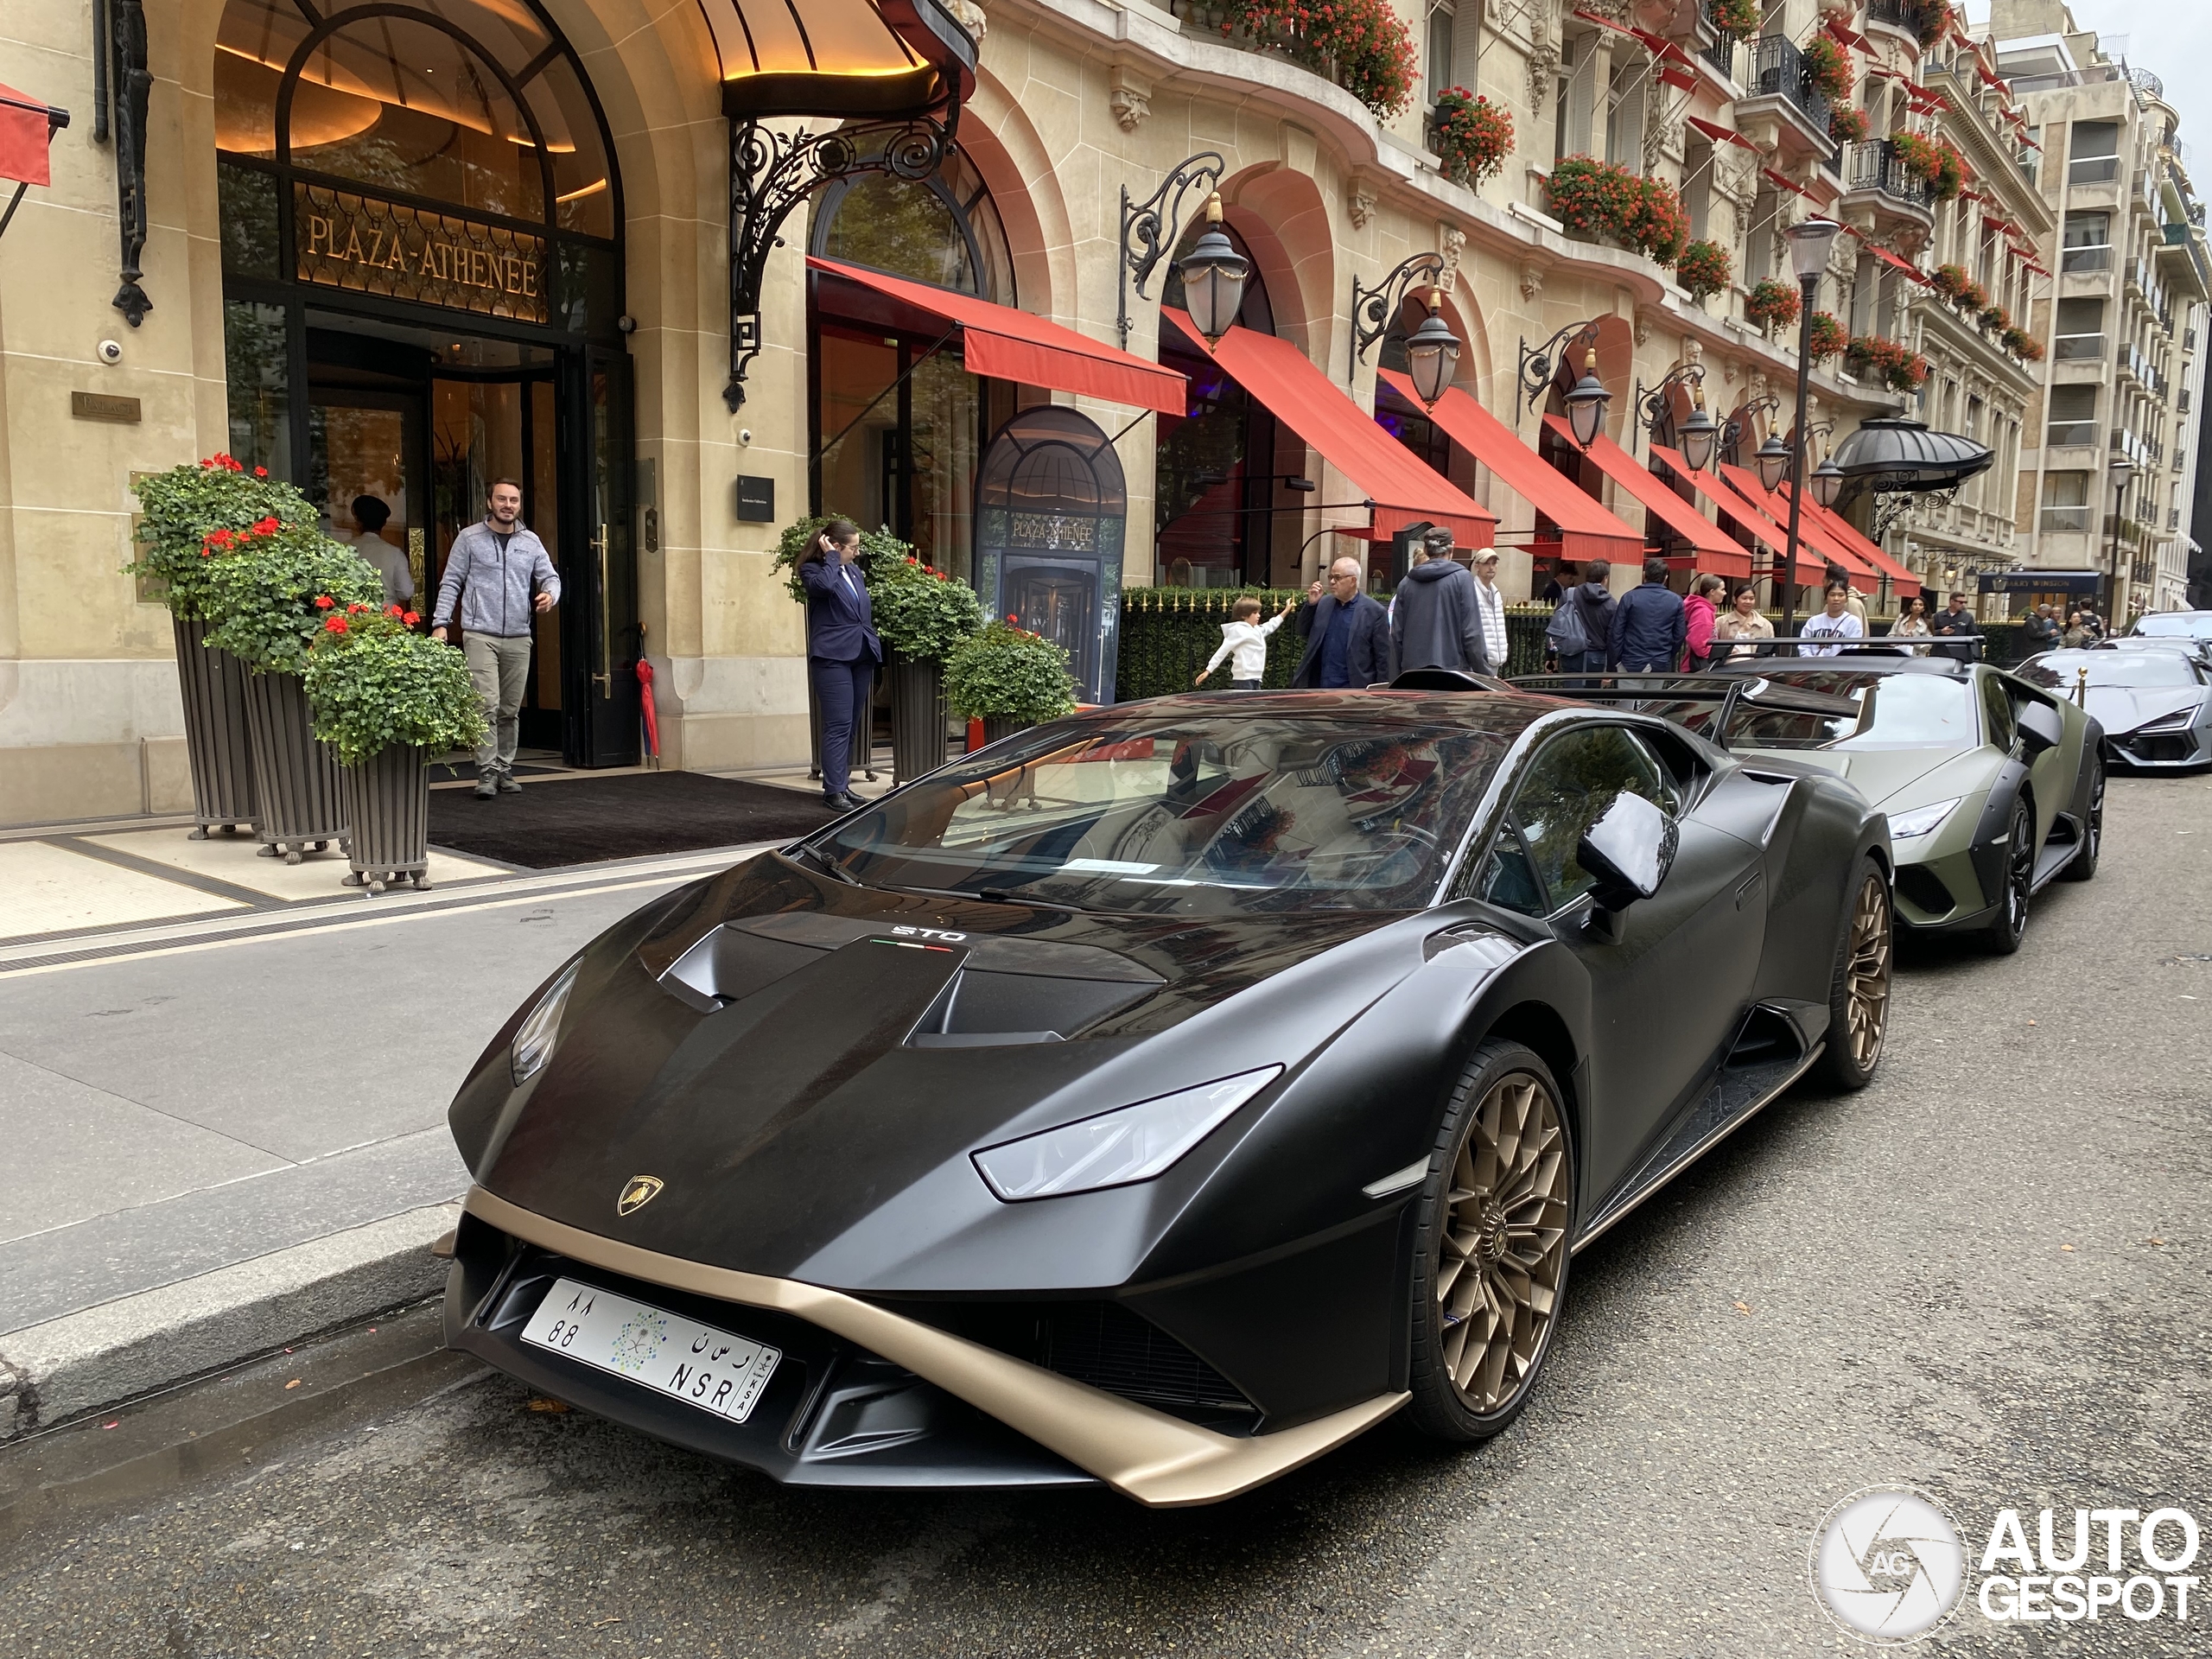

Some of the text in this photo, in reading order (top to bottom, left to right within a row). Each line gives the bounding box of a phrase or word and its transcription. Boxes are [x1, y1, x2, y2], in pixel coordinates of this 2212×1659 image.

[891, 925, 967, 942] STO
[548, 1319, 579, 1347] 88
[668, 1363, 733, 1408] NSR
